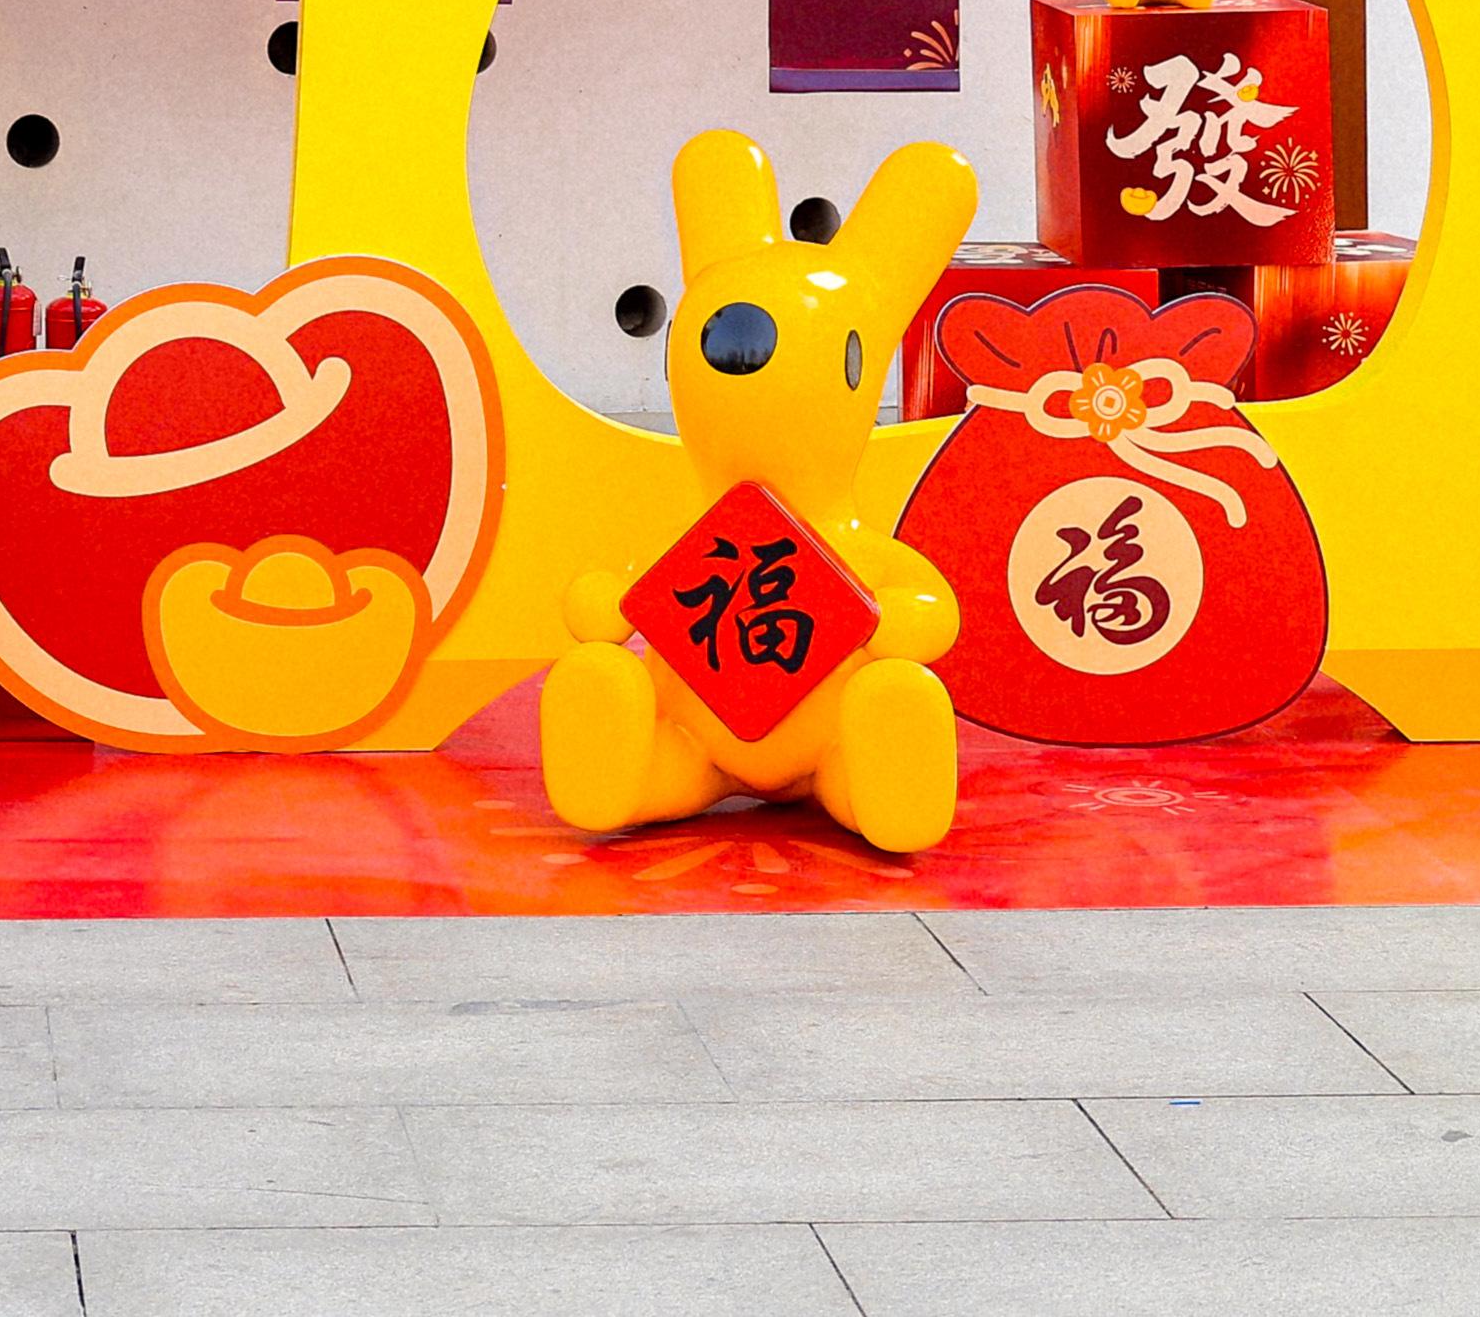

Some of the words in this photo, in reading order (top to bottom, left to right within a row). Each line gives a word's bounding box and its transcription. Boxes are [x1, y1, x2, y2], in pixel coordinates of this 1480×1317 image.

[1105, 52, 1301, 227] 發
[671, 537, 816, 675] 福
[1032, 493, 1174, 646] 福
